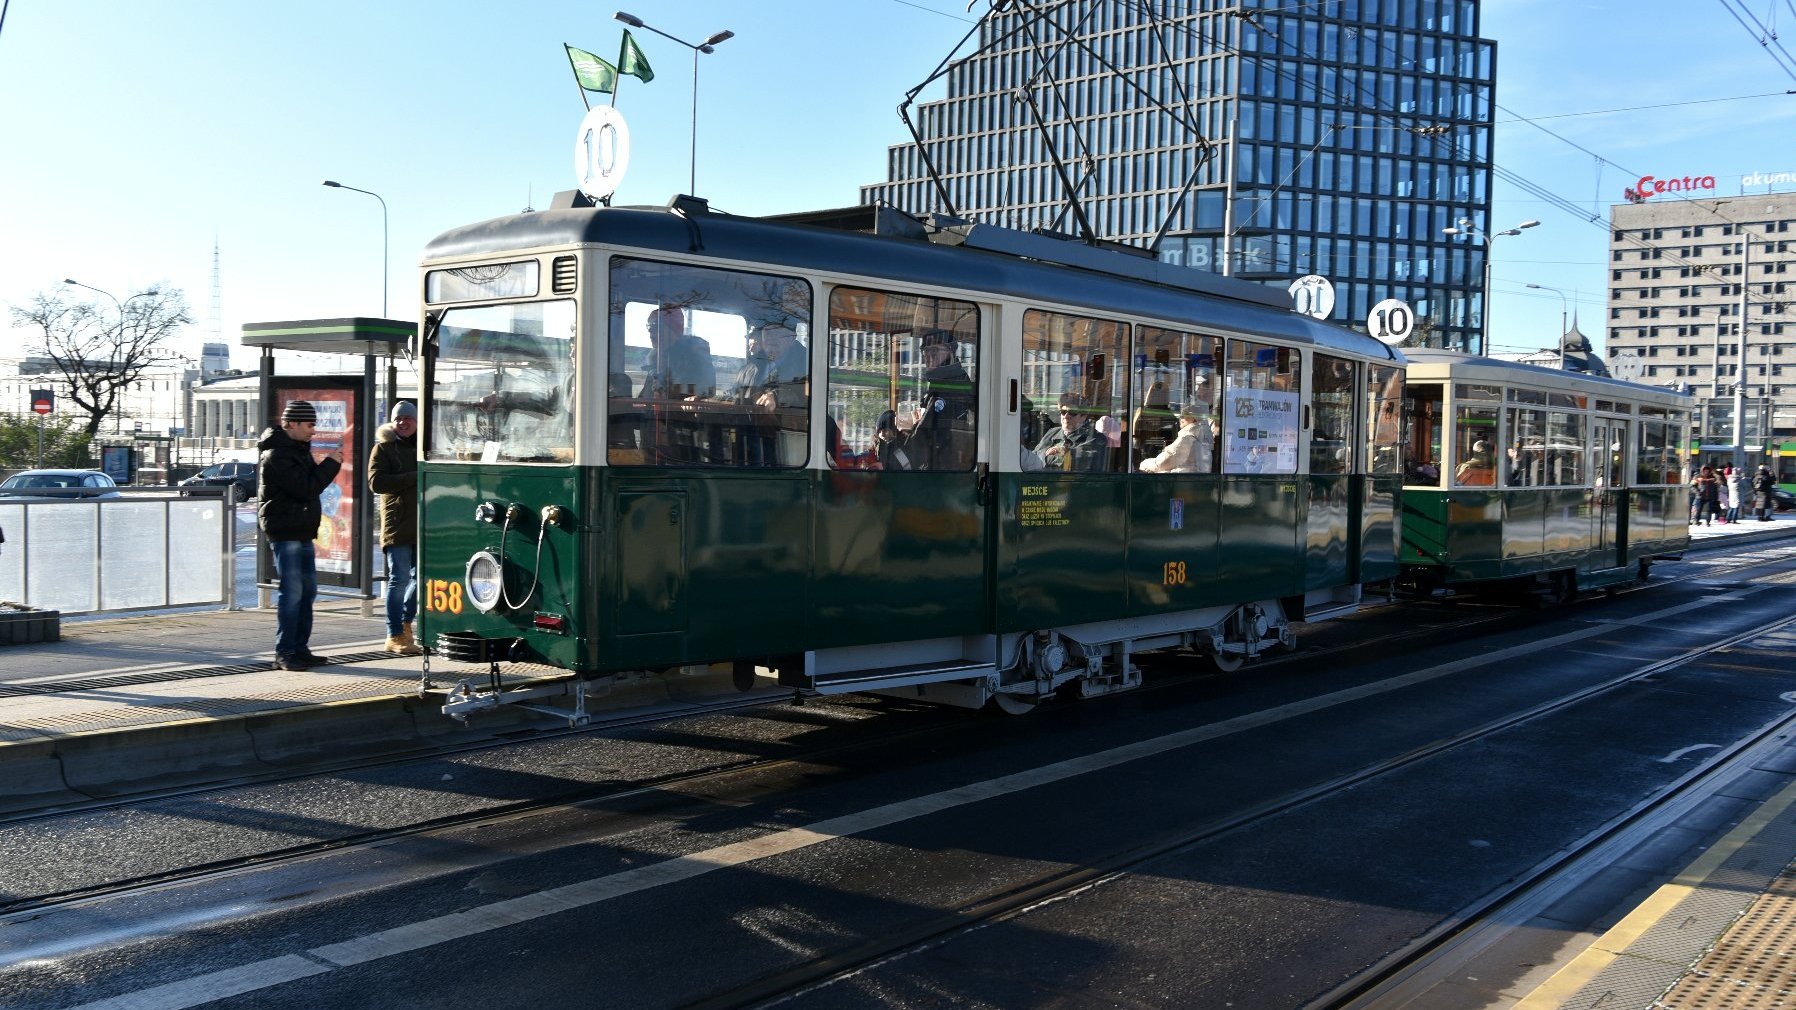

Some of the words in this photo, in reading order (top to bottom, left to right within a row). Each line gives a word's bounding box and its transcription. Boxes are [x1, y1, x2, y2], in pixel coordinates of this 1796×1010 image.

[583, 122, 618, 184] 10
[1636, 175, 1716, 198] Centra
[1376, 307, 1408, 337] 10
[1022, 485, 1048, 496] WEJŚCIE
[1162, 561, 1187, 585] 158
[425, 578, 464, 615] 158
